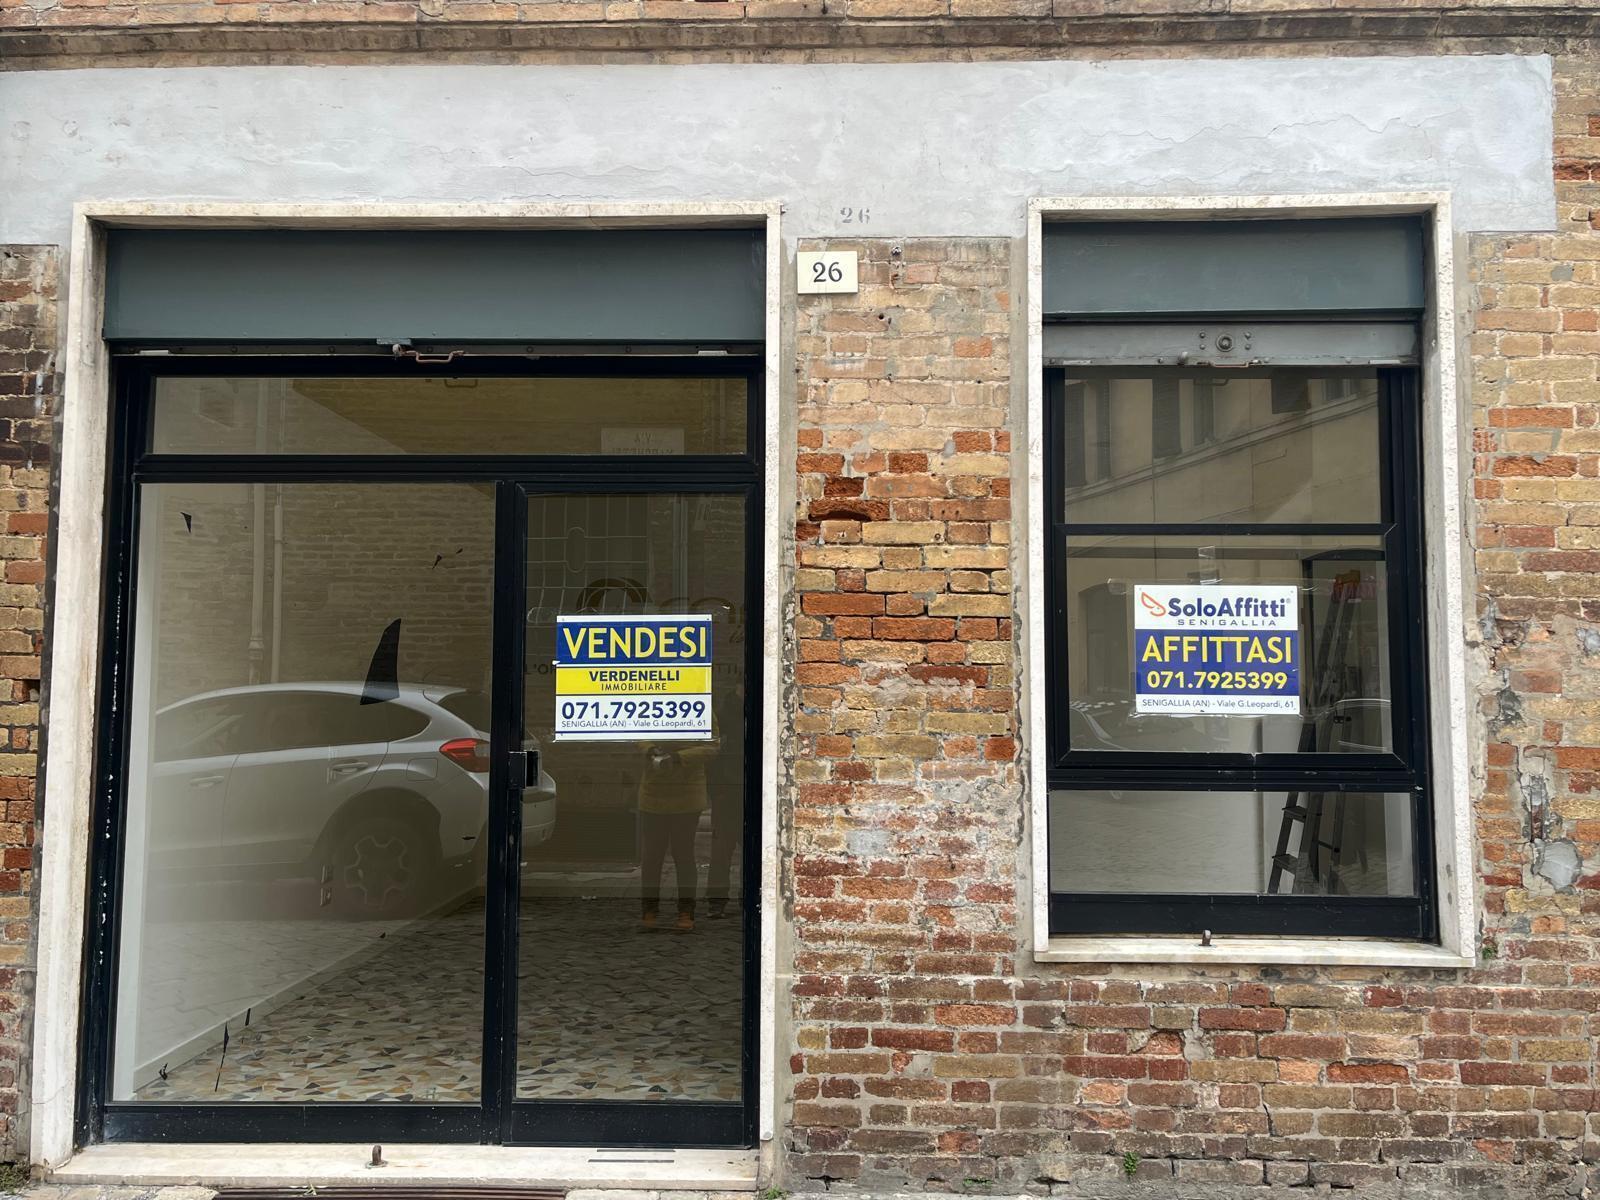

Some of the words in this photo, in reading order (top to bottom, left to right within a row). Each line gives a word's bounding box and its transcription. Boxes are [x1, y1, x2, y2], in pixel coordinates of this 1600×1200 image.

[812, 261, 843, 283] 26
[1168, 597, 1286, 617] SoloAffitti
[563, 626, 706, 659] VENDESI
[1142, 635, 1292, 664] AFFITTASI
[589, 670, 680, 682] VERDENELLI
[1147, 671, 1288, 690] 071.7925399
[601, 683, 667, 691] IMMOBILIARE
[562, 700, 706, 720] 071.7925399
[1142, 699, 1190, 707] SENIGALLIA
[1192, 699, 1211, 708] (AN)
[1217, 699, 1236, 708] Viale
[1285, 700, 1294, 708] 61
[562, 720, 608, 728] SENIGALLIA
[609, 720, 627, 728] (AN)
[697, 719, 706, 727] 61
